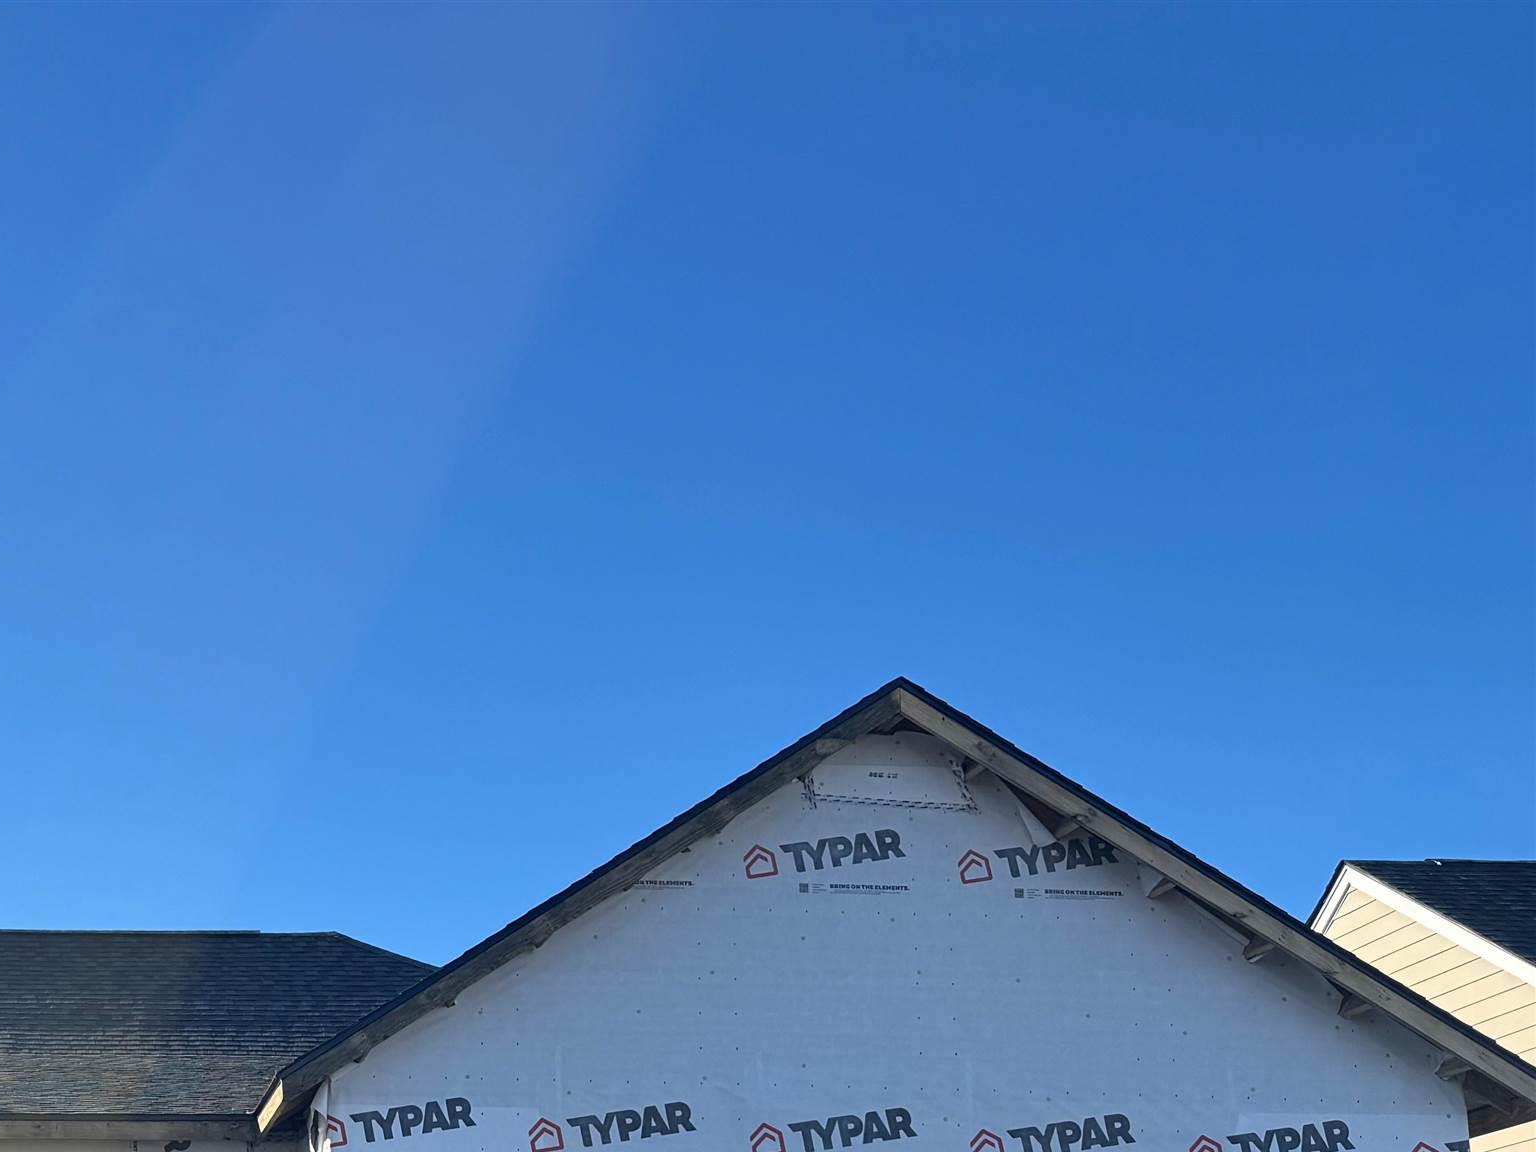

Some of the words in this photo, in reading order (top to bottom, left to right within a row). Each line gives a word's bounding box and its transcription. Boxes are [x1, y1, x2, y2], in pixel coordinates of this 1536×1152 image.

[779, 829, 906, 873] TYPAR
[993, 836, 1120, 879] TYPAR
[349, 1097, 477, 1143] TYPAR
[566, 1101, 697, 1148] TYPAR
[787, 1107, 919, 1152] TYPAR
